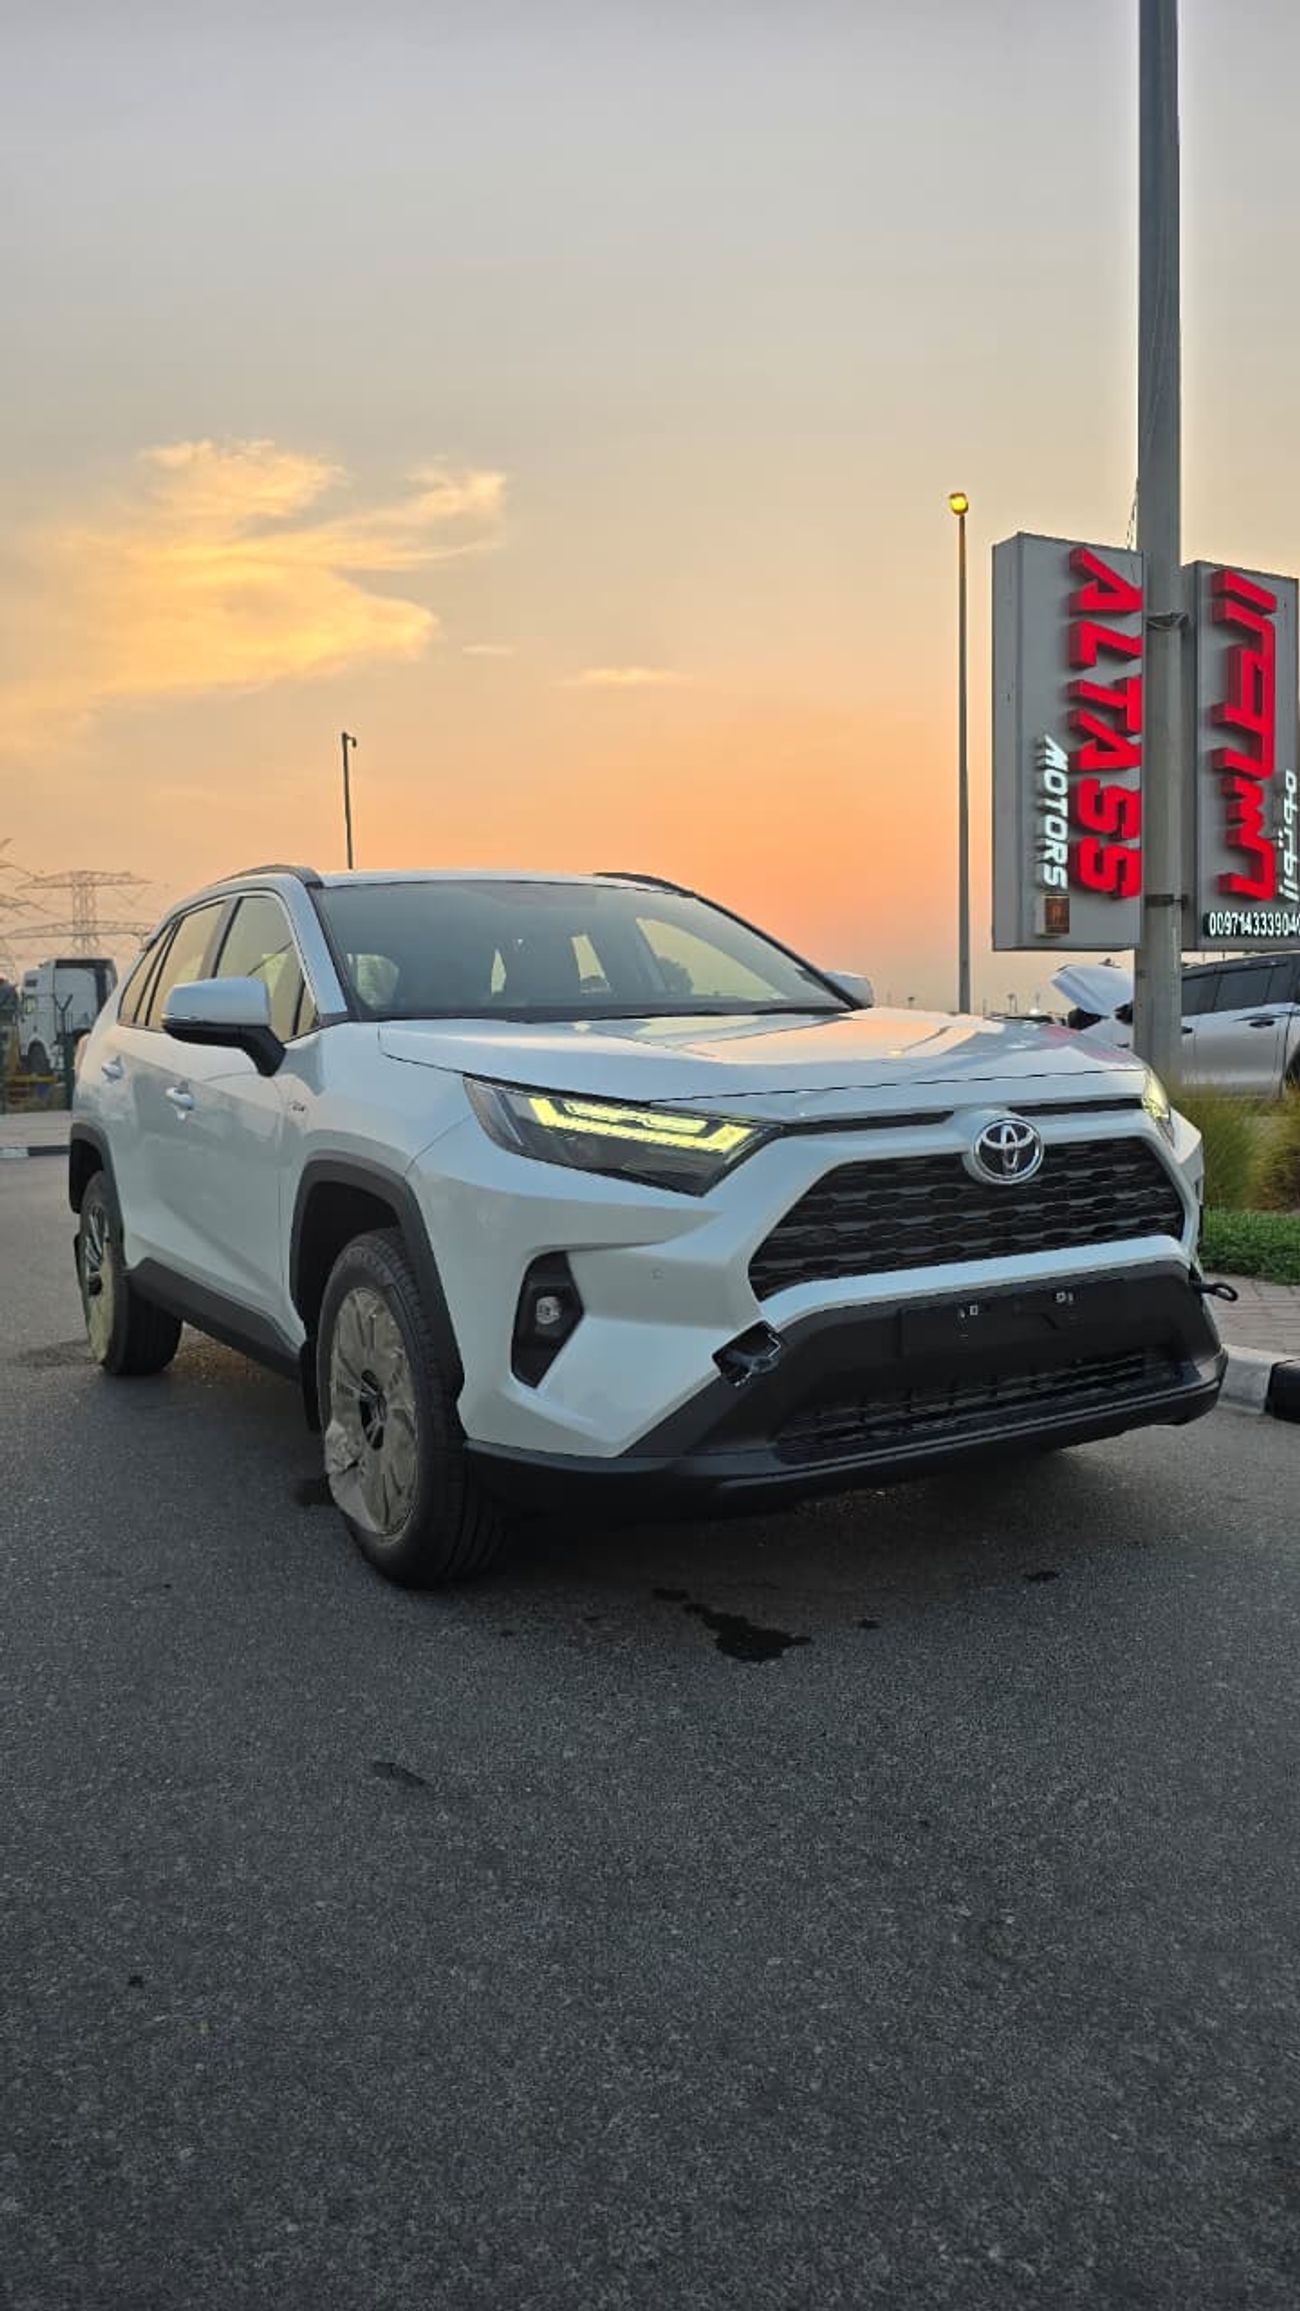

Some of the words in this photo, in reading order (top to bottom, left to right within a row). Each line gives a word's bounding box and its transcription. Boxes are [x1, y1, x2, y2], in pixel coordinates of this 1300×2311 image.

[1043, 734, 1068, 889] MOTORS
[1070, 547, 1143, 897] ALTASS
[1213, 569, 1275, 901] الطاس
